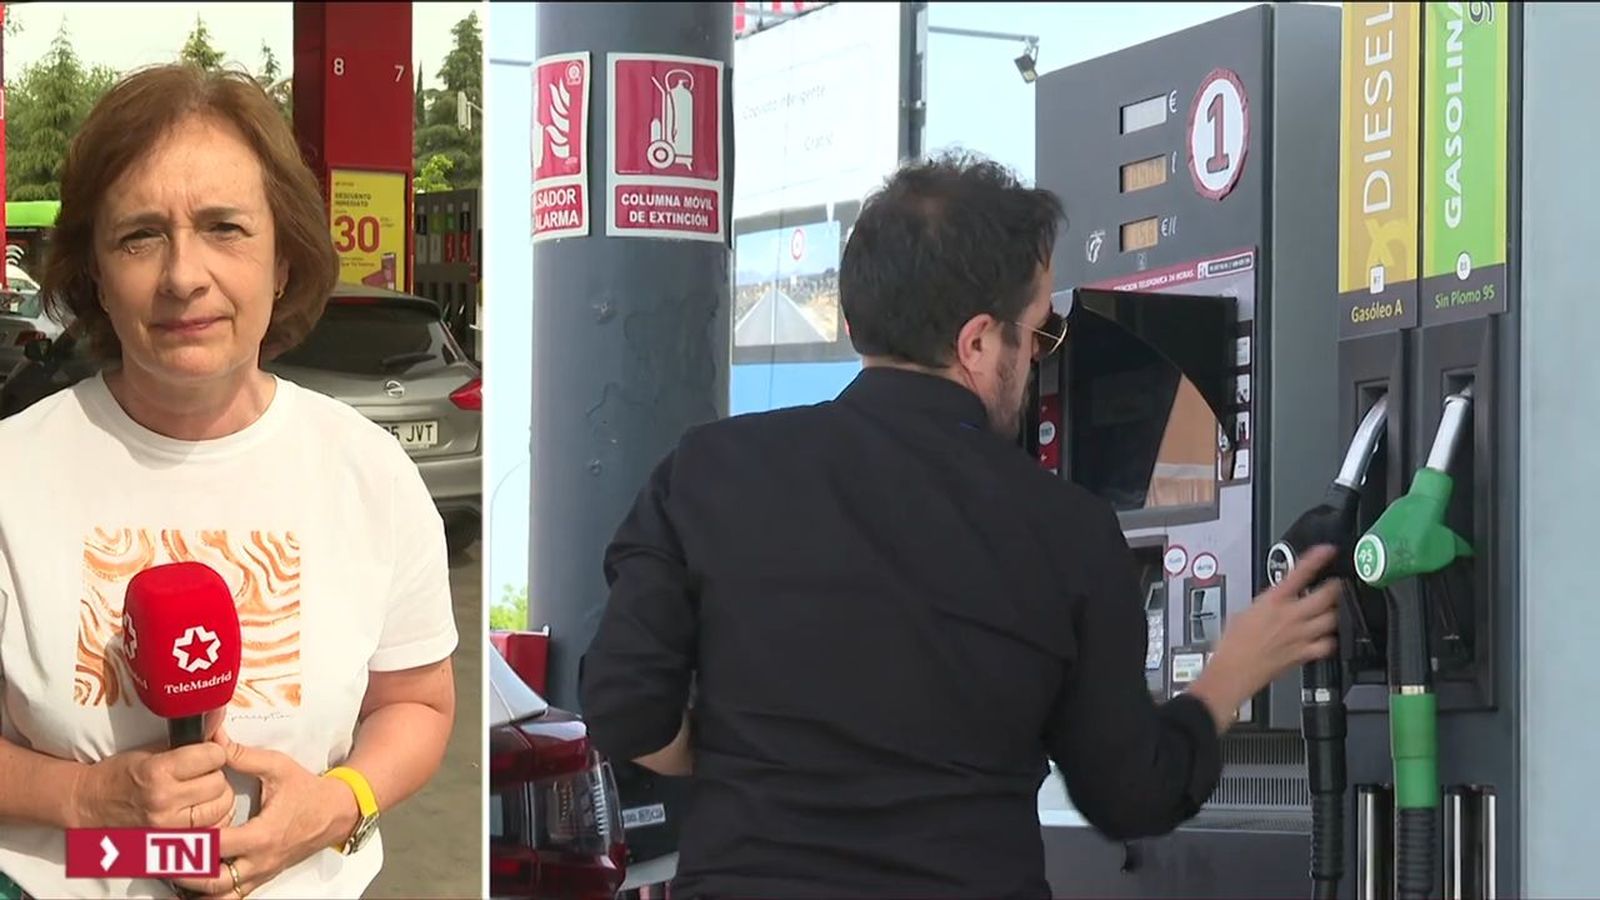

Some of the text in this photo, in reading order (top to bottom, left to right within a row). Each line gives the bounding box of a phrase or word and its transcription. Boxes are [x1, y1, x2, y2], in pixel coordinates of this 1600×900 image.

[333, 58, 345, 76] 8
[394, 65, 405, 82] 7
[1363, 2, 1394, 214] DIESEL
[1206, 93, 1230, 174] 1
[621, 193, 714, 210] COLUMNA MÓVIL
[629, 211, 709, 227] DE EXTINCIÓN
[334, 215, 381, 253] 30
[1435, 284, 1495, 309] Sin Plomo 95
[1351, 298, 1403, 322] Gasóleo A
[406, 424, 433, 442] JVT
[164, 670, 233, 694] TeleMadrid
